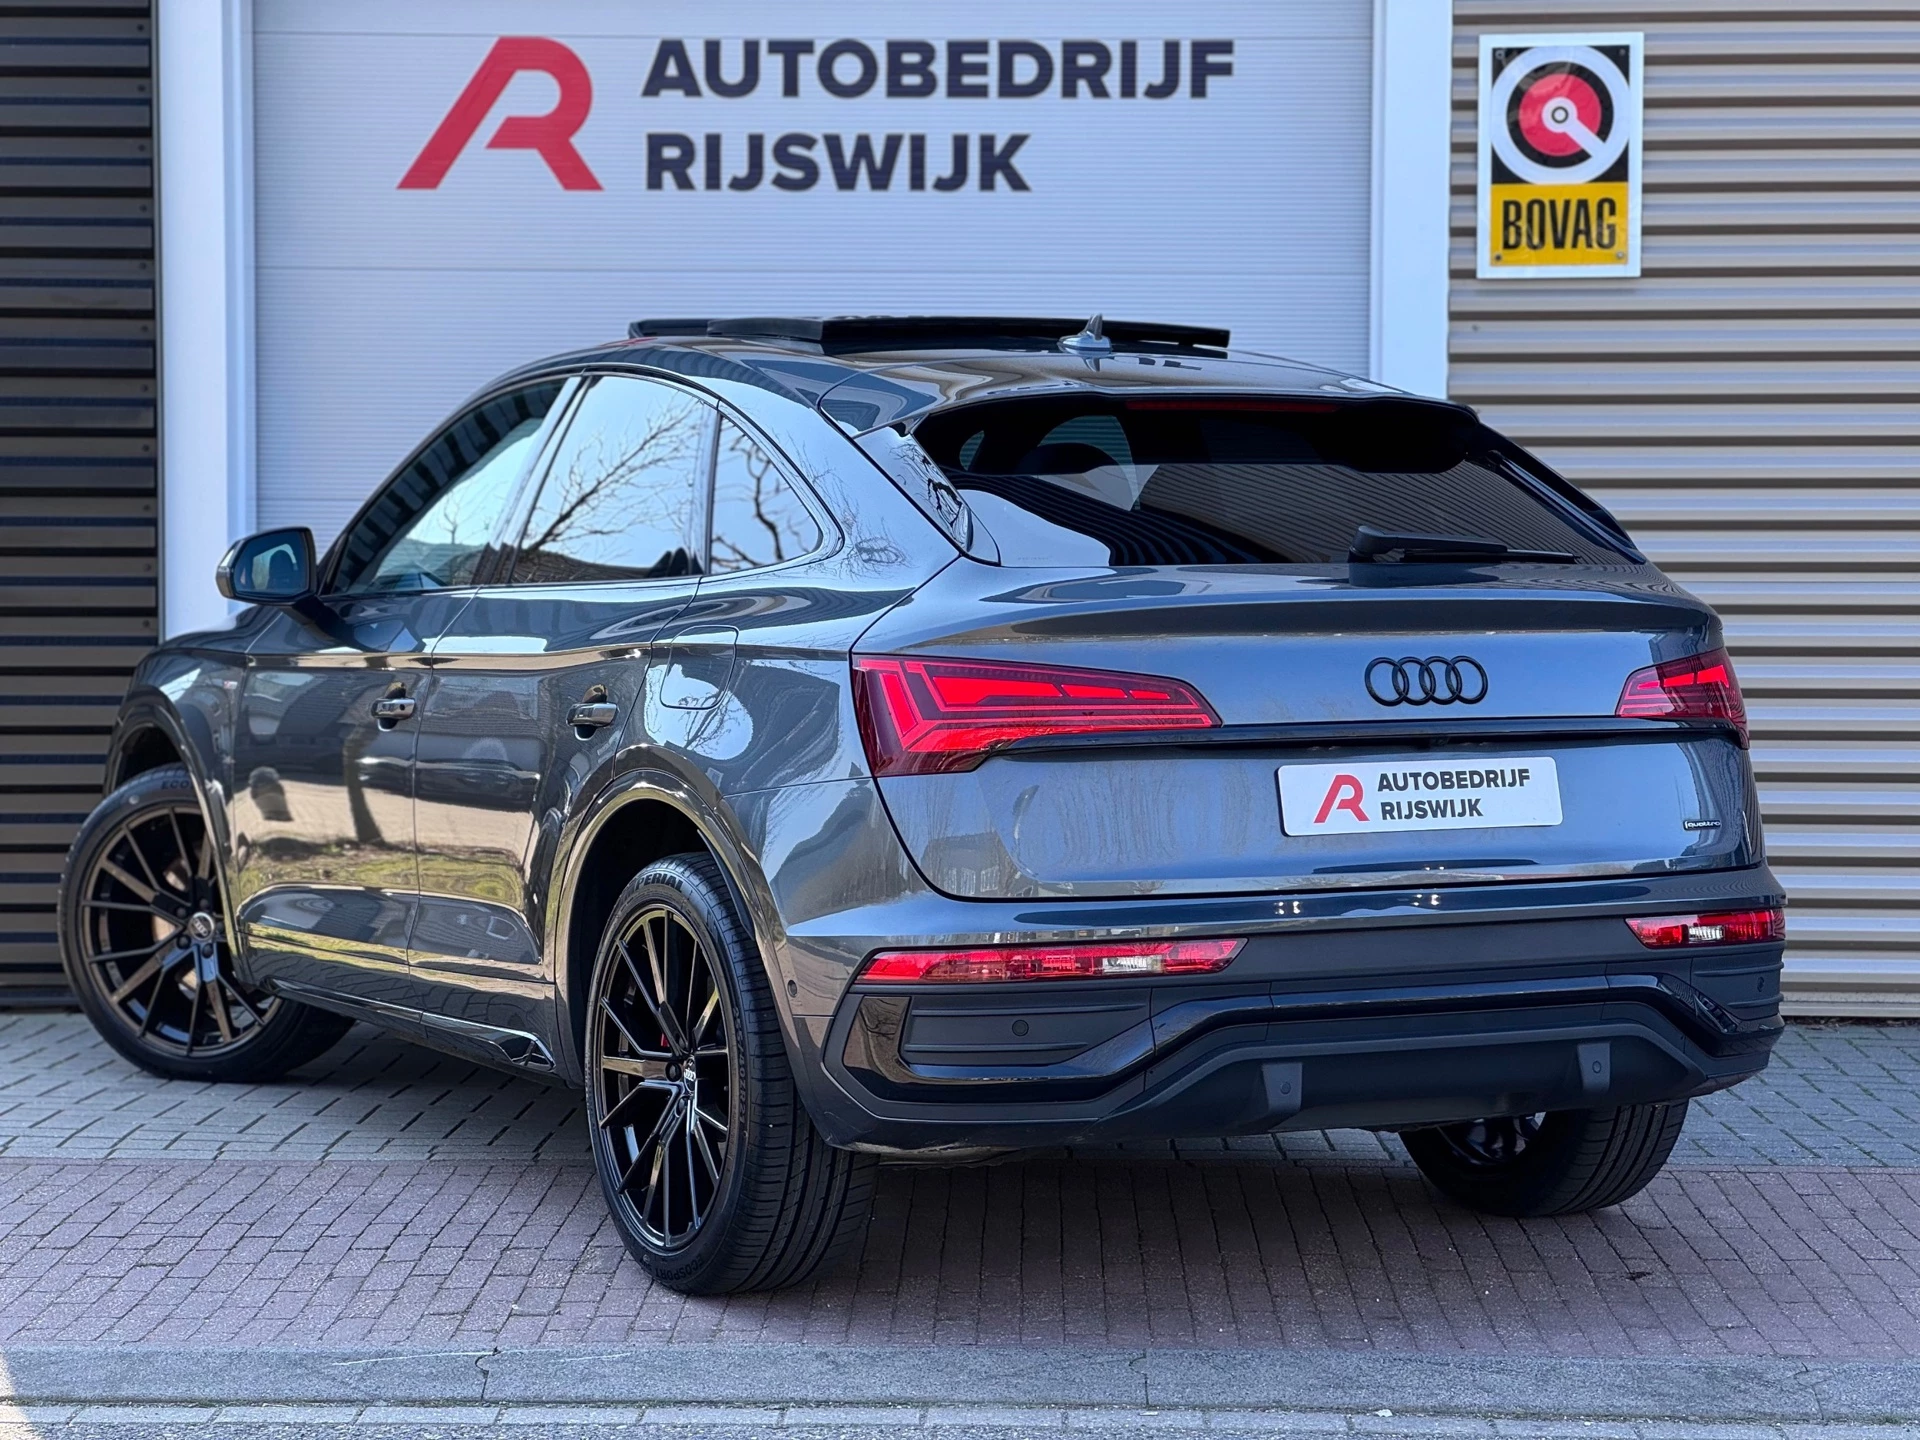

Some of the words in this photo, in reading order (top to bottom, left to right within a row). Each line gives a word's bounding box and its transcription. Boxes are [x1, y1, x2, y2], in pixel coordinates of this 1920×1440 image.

[641, 38, 1236, 99] AUTOBEDRIJF
[645, 133, 1032, 192] RIJSWIJK
[1502, 197, 1617, 250] BOVAG
[161, 779, 191, 790] ECO
[1377, 768, 1531, 792] AUTOBEDRIJF
[1380, 798, 1484, 821] RIJSWIJK
[1685, 820, 1721, 829] quattro
